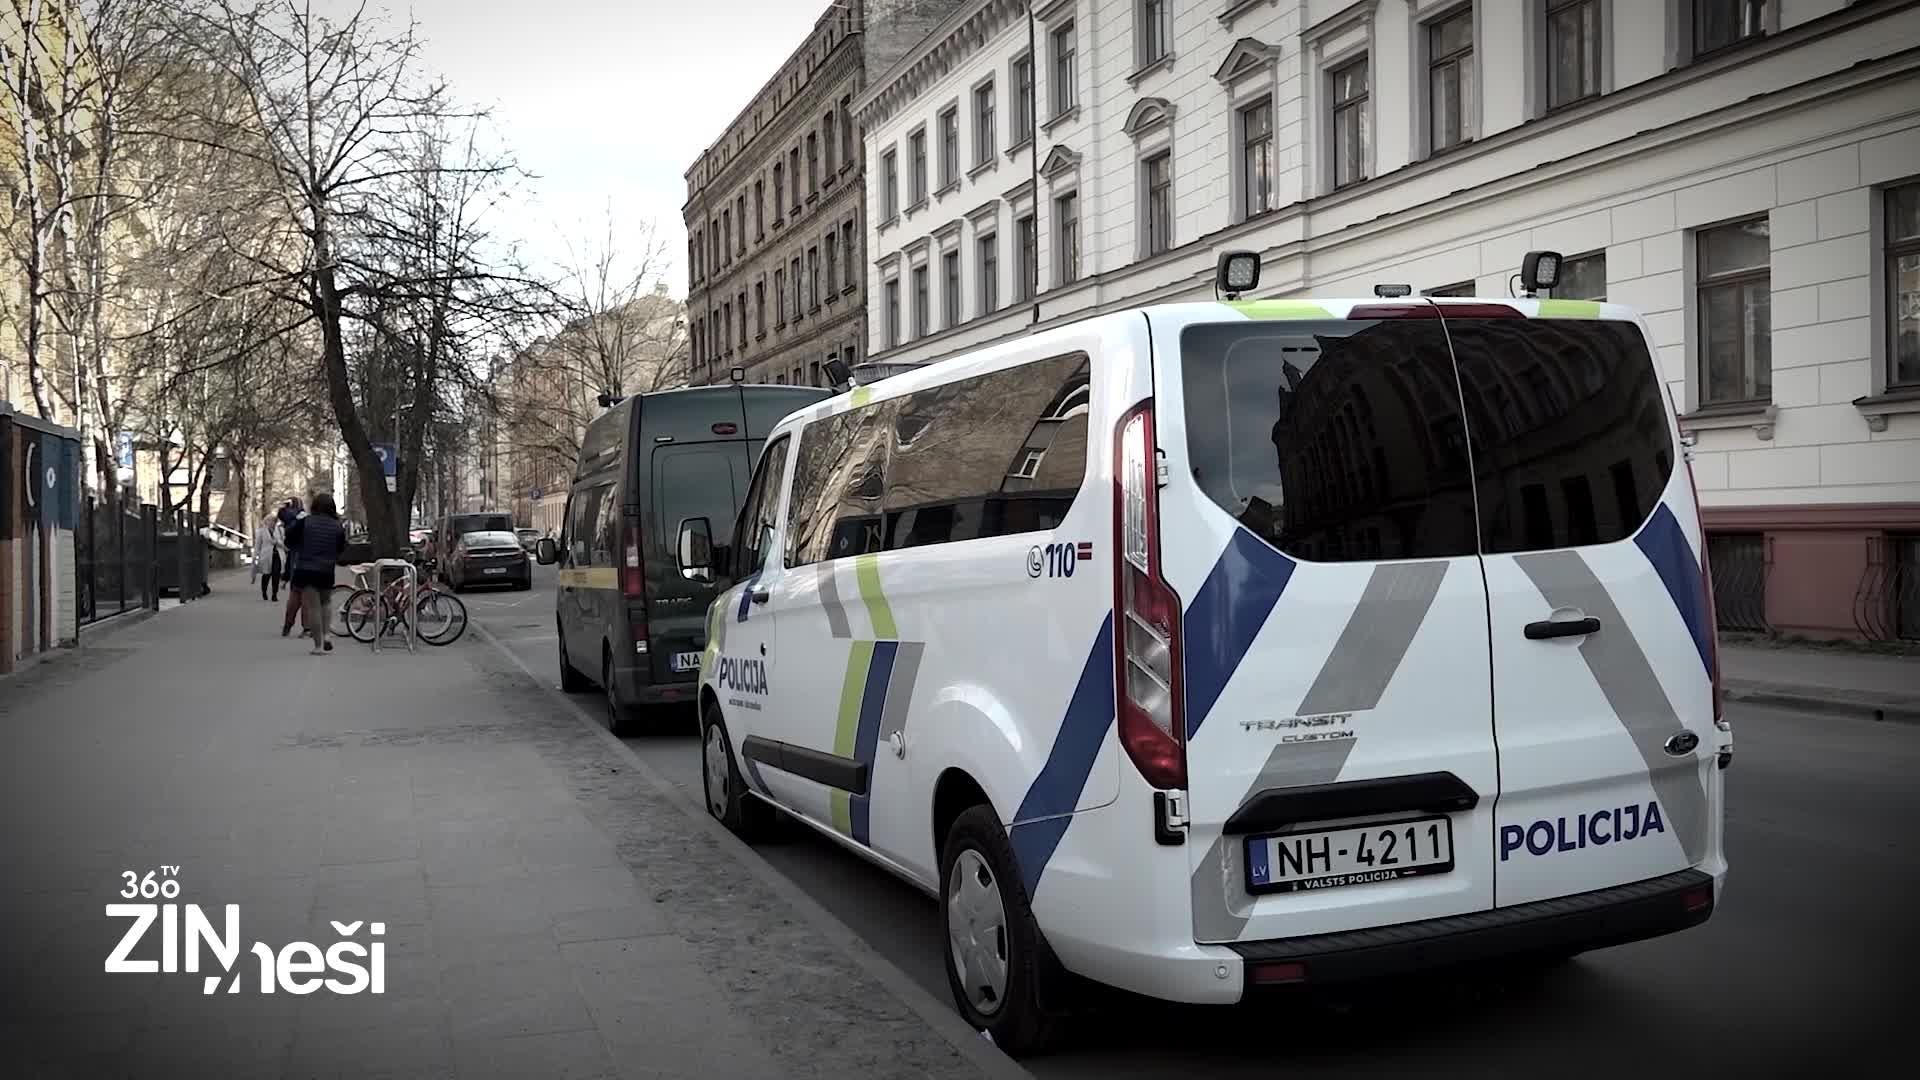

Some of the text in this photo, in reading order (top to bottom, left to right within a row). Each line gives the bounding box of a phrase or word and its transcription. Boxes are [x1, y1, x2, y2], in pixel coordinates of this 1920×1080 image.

[1045, 542, 1075, 578] 110
[719, 657, 768, 696] POLICIJA
[1239, 713, 1352, 732] TRANSIT
[1281, 730, 1354, 743] CUSTOM
[1500, 801, 1665, 861] POLICIJA
[1278, 824, 1440, 877] NH-4211
[1252, 865, 1267, 877] LV
[1304, 870, 1399, 890] VALSTS POLICIJA
